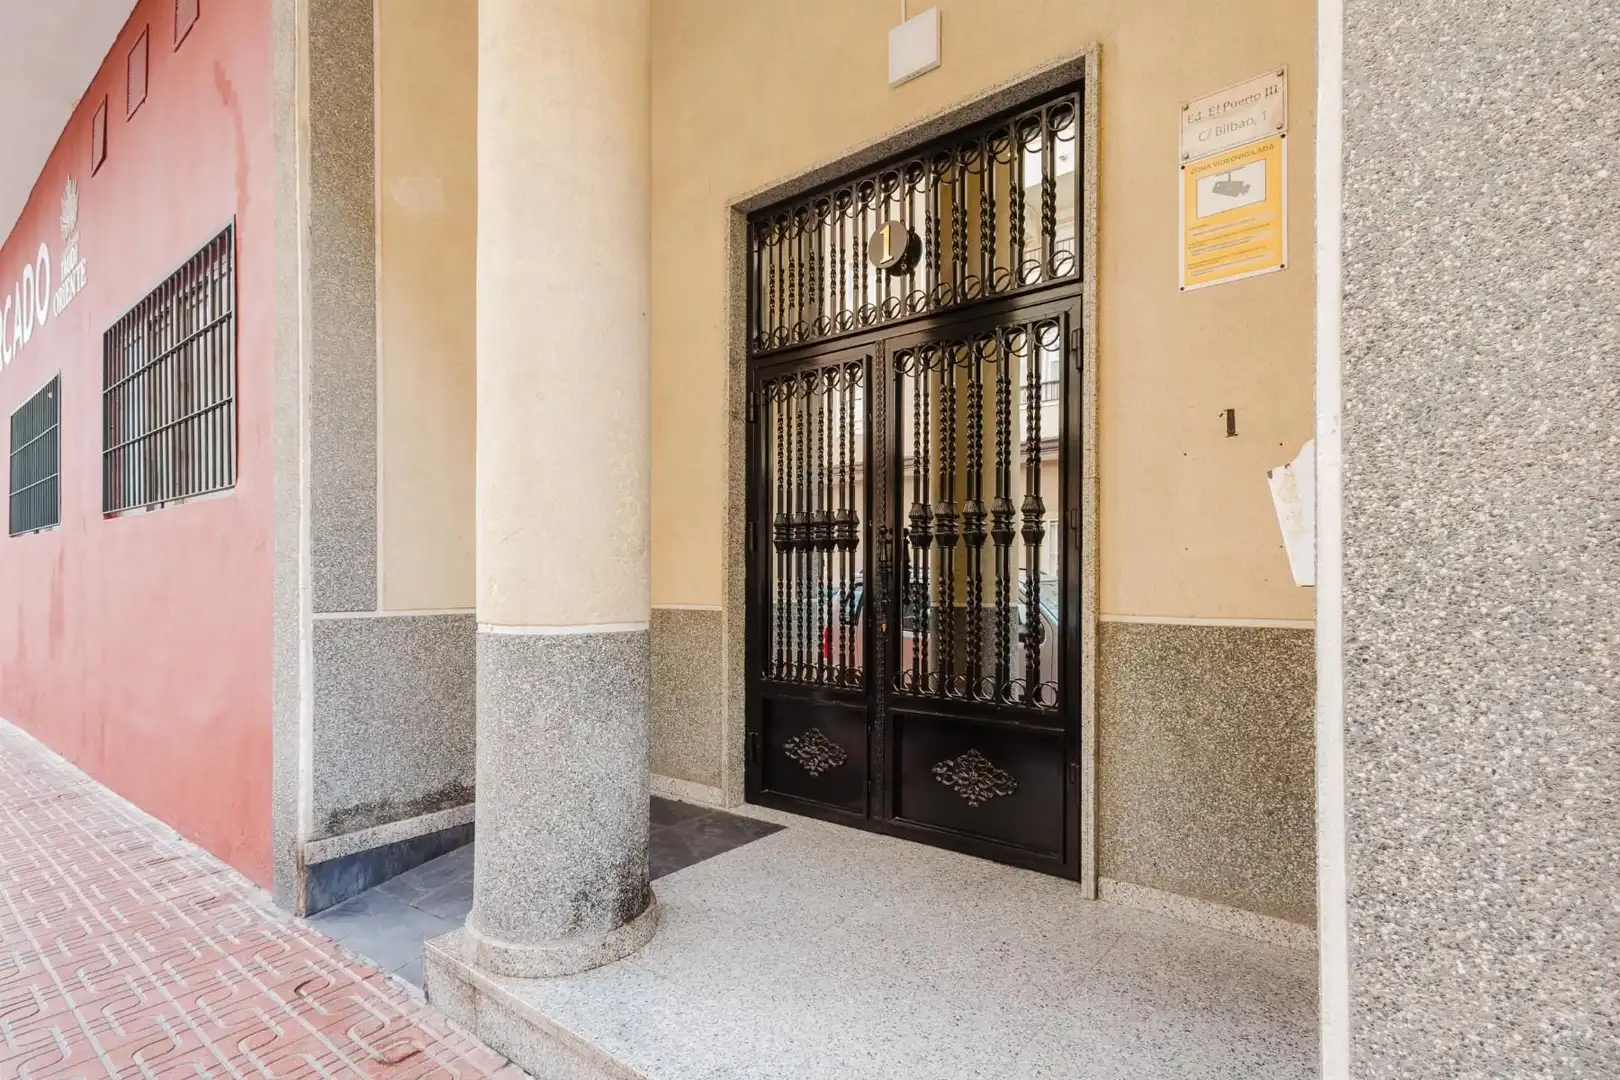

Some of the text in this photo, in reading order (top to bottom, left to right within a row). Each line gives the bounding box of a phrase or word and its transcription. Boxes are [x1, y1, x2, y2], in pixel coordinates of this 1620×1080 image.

[1187, 84, 1278, 124] Ed. El Puerto III
[1198, 127, 1212, 142] C/
[1215, 117, 1257, 137] Bilbao,
[1190, 143, 1275, 175] ZONA VIDEOVIGILADA
[880, 224, 894, 265] 1
[0, 242, 50, 372] CADO
[53, 257, 88, 317] ORIENTE
